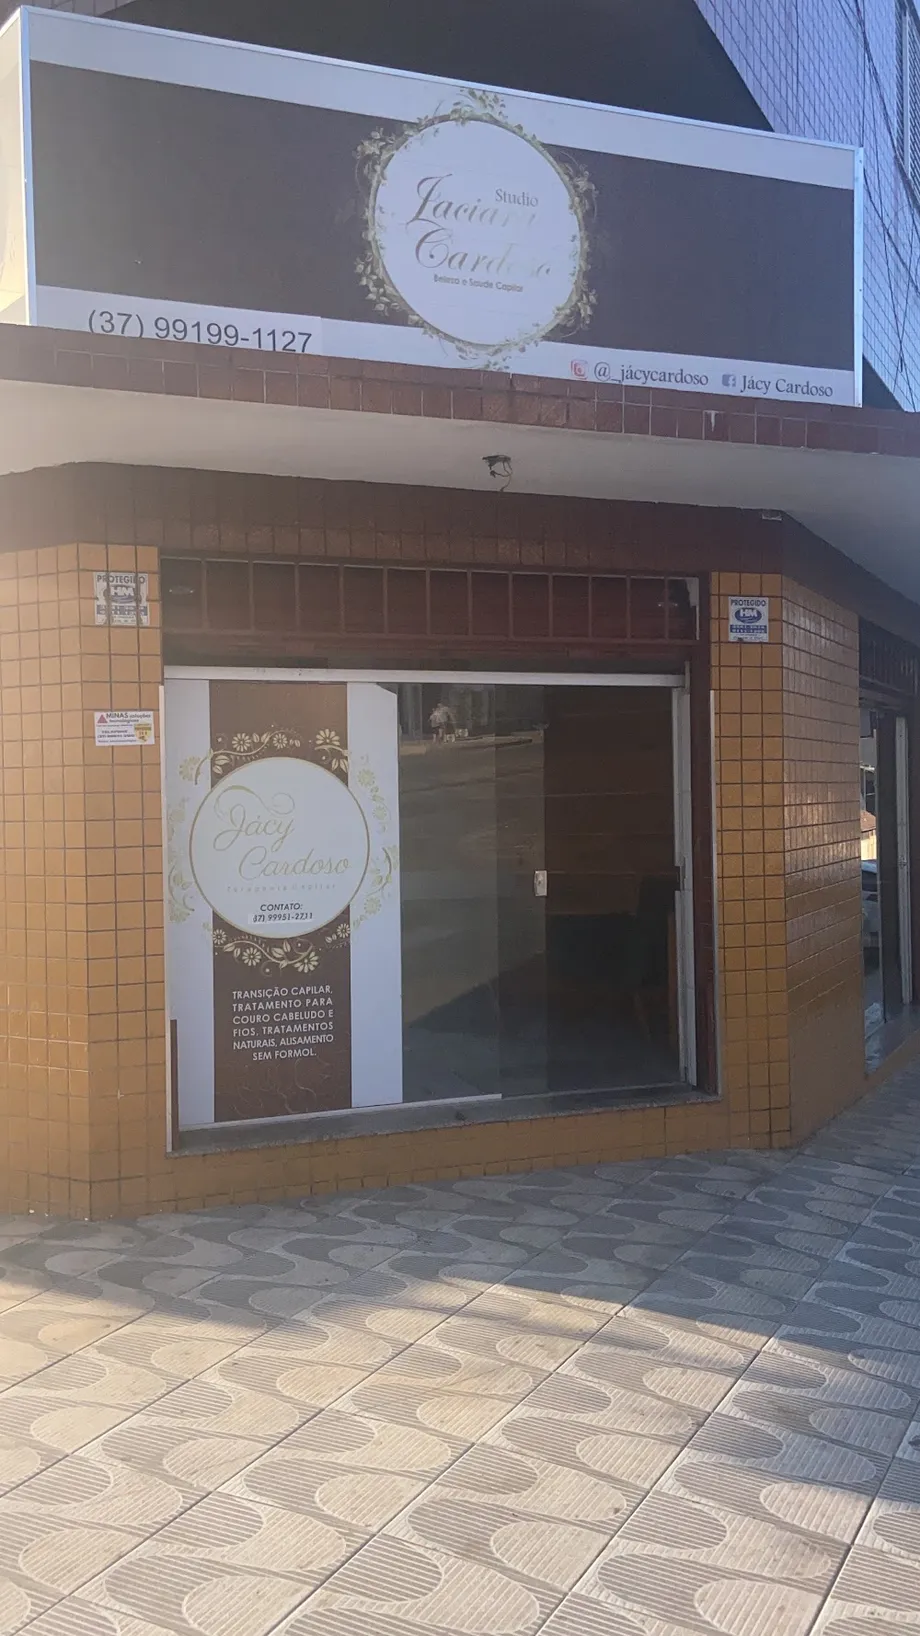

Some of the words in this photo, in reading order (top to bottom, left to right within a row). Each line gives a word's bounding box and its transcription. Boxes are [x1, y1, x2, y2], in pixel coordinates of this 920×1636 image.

[495, 188, 539, 208] Studio
[496, 281, 523, 293] Capilar
[88, 309, 144, 338] (37)
[154, 316, 312, 353] 99199-1127
[740, 375, 771, 394] Jácy
[775, 379, 833, 397] Cardoso
[97, 575, 146, 584] PROTEGIO
[213, 785, 295, 852] Jácy
[239, 846, 350, 881] Cardoso
[260, 902, 303, 911] CONTATO:
[232, 987, 289, 999] TRANSIÇÃO
[291, 985, 333, 996] CAPILAR,
[232, 999, 302, 1012] TRATAMENTO
[305, 997, 333, 1007] PARA
[232, 1014, 270, 1025] COURO
[273, 1010, 325, 1022] CABELUDO
[328, 1009, 334, 1018] E
[233, 1027, 259, 1037] FIOS,
[262, 1022, 334, 1035] TRATAMENTOS
[233, 1038, 278, 1050] NATURAIS,
[279, 1034, 334, 1046] ALISAMENTO
[252, 1051, 272, 1061] SEM
[274, 1048, 317, 1060] FORMOL.
